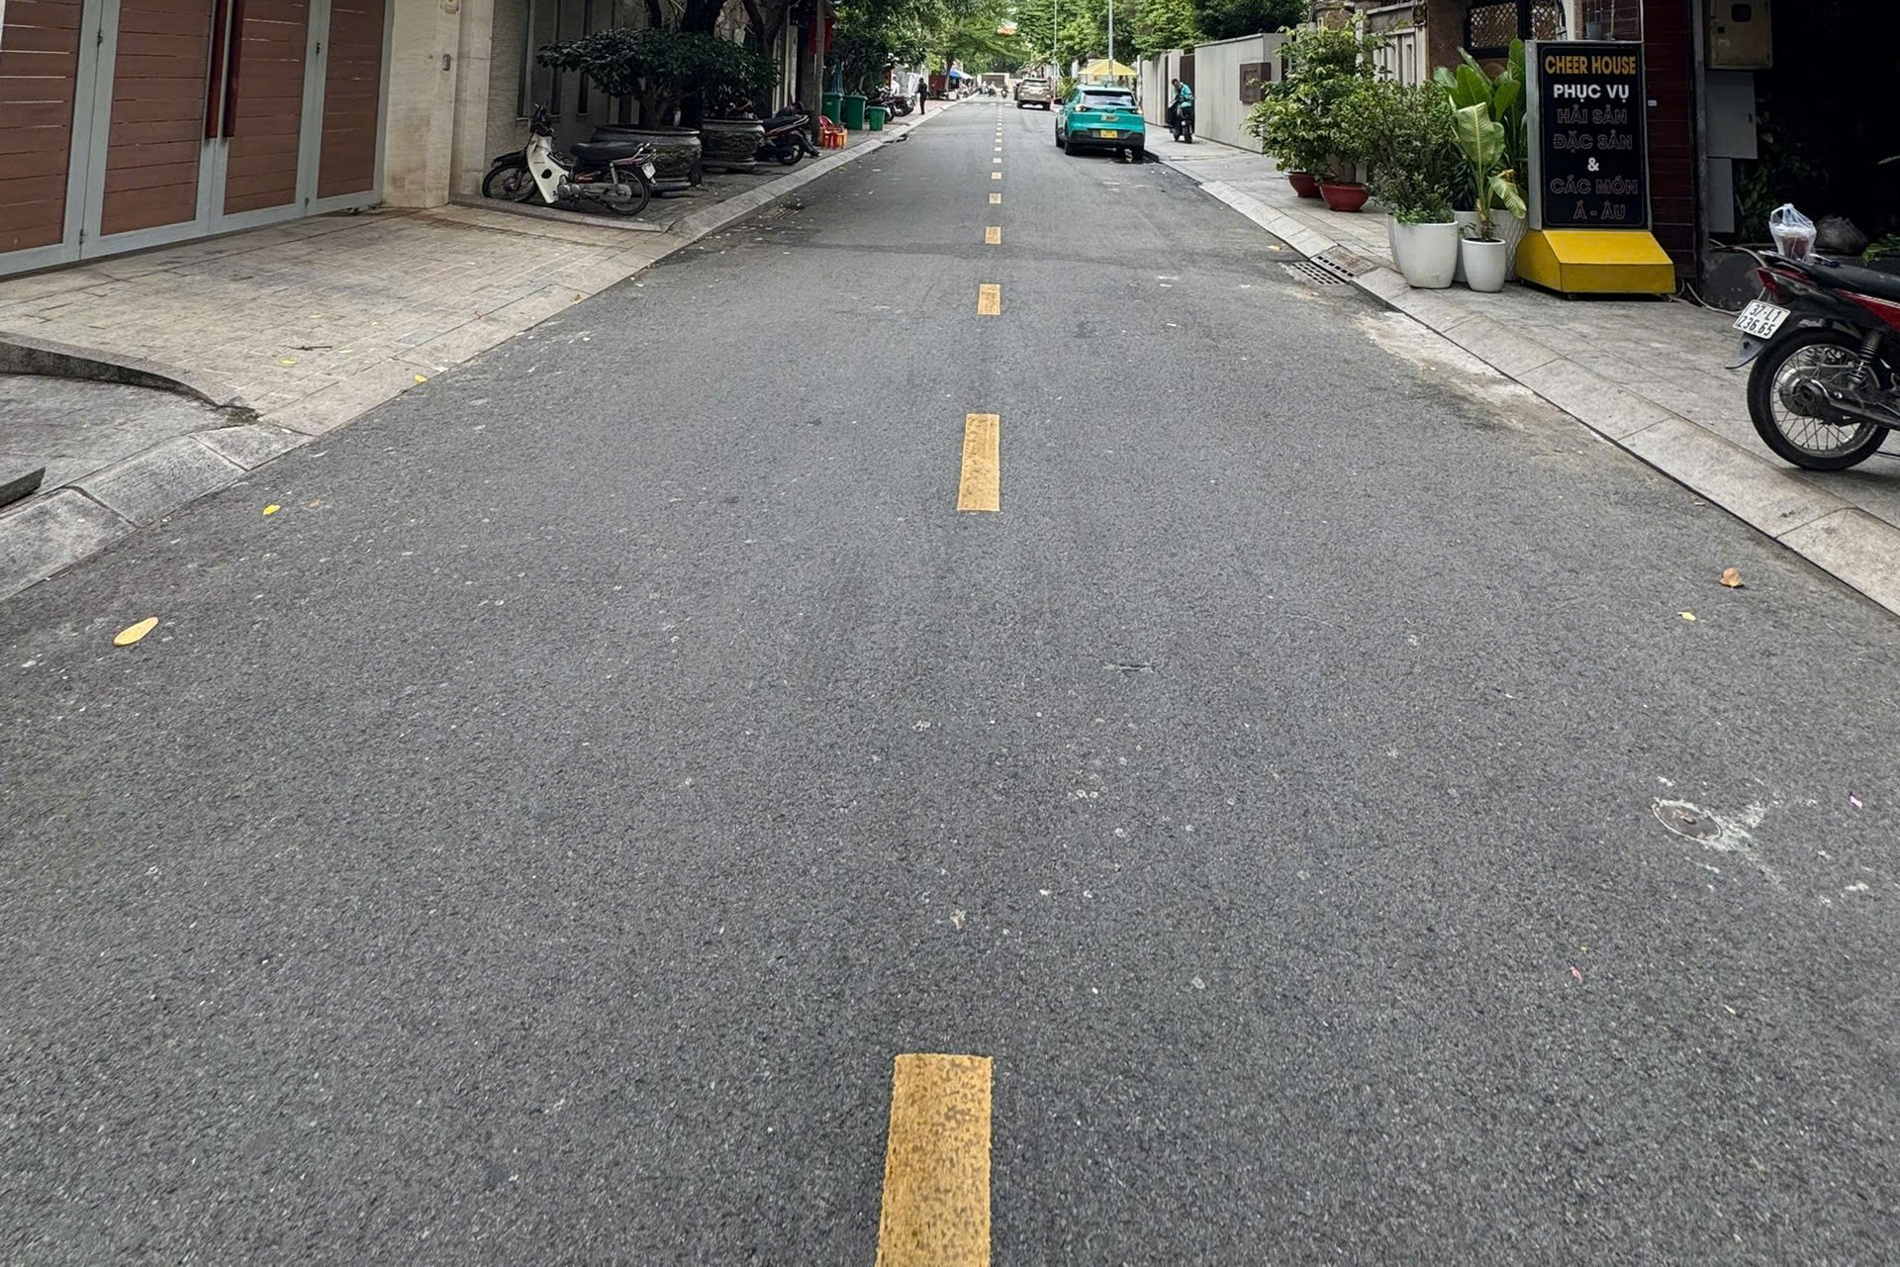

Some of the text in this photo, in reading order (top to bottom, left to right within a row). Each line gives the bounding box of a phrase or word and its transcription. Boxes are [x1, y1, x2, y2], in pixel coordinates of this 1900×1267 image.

[1545, 55, 1637, 75] CHEER HOUSE
[1553, 84, 1629, 103] PHỤC VỤ
[1557, 104, 1627, 124] HẢI SẢN
[1552, 129, 1632, 153] ĐẶC SẢN
[1587, 157, 1600, 172] &
[1550, 174, 1591, 194] CÁC
[1600, 200, 1626, 220] ÂU
[1749, 304, 1782, 322] 37-L1
[1737, 315, 1776, 336] 236.65
